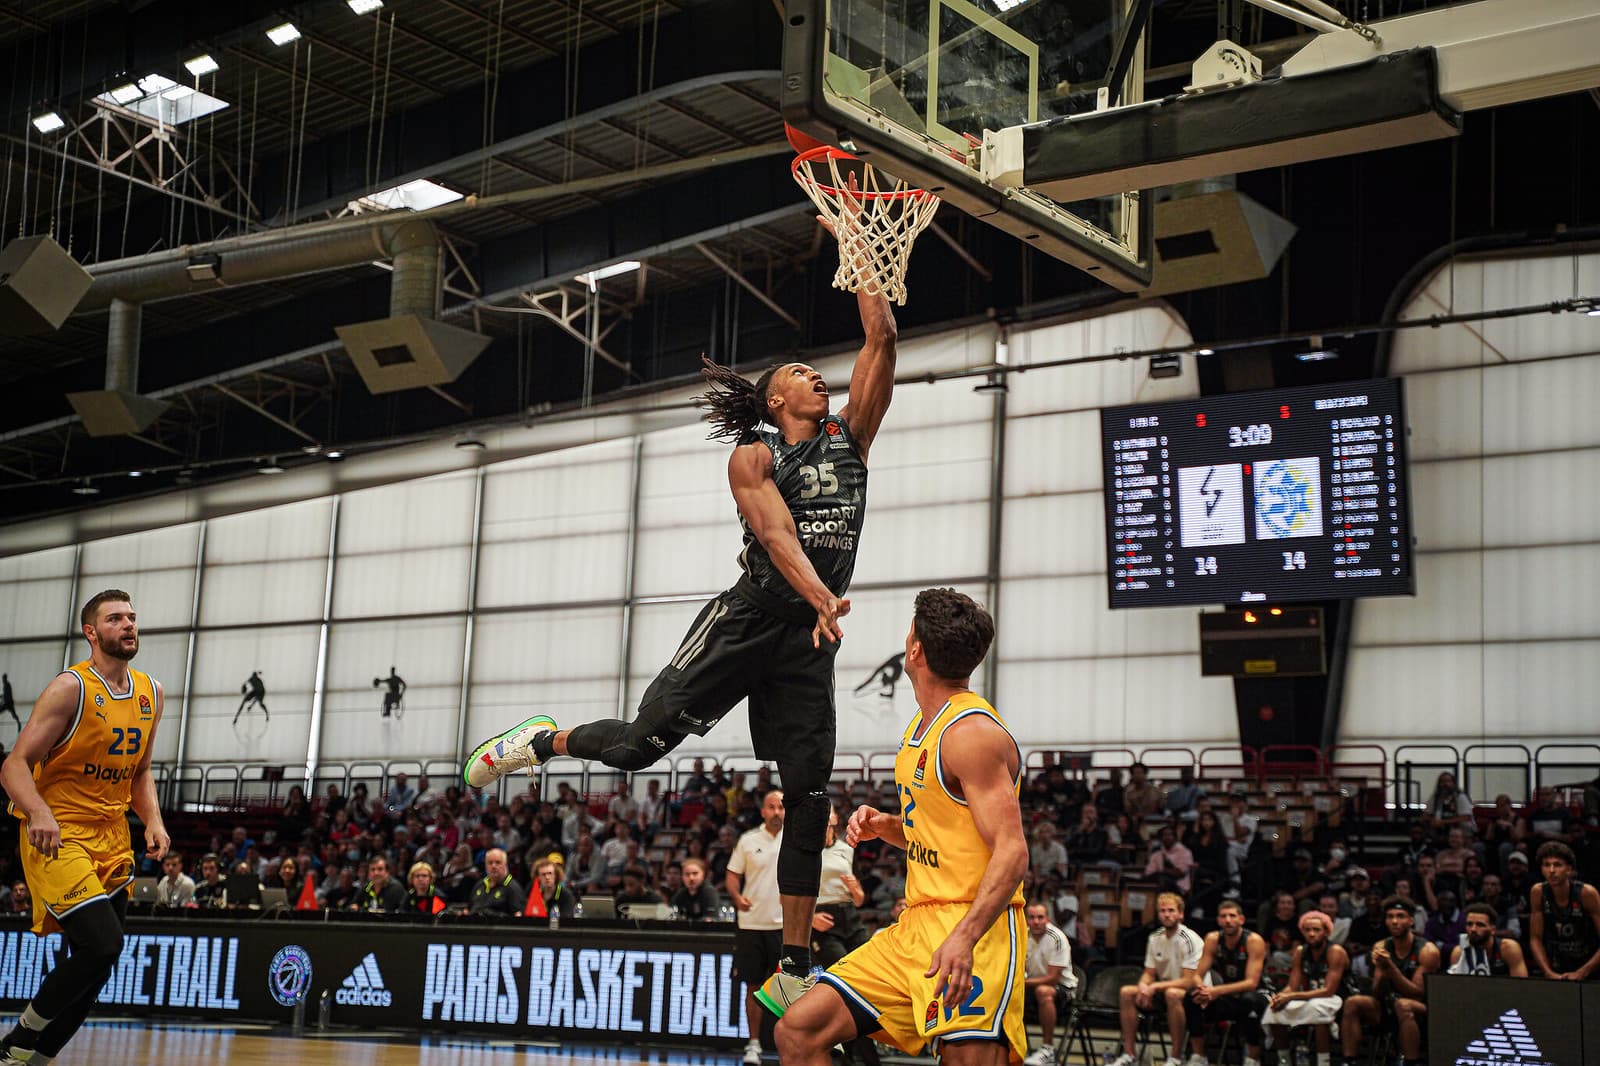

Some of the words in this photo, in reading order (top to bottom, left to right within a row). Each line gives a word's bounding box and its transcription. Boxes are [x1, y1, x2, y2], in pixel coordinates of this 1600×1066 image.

[1228, 423, 1273, 448] 3:09
[799, 462, 839, 499] 35
[805, 505, 857, 520] SMART
[802, 534, 854, 551] THINGS
[1194, 556, 1218, 576] 14
[1281, 550, 1307, 571] 14
[108, 727, 142, 755] 23
[906, 840, 940, 869] tika
[63, 886, 88, 902] Rapyd
[0, 930, 63, 1000] ARIS
[422, 943, 523, 1025] PARIS
[335, 986, 392, 1007] adidas
